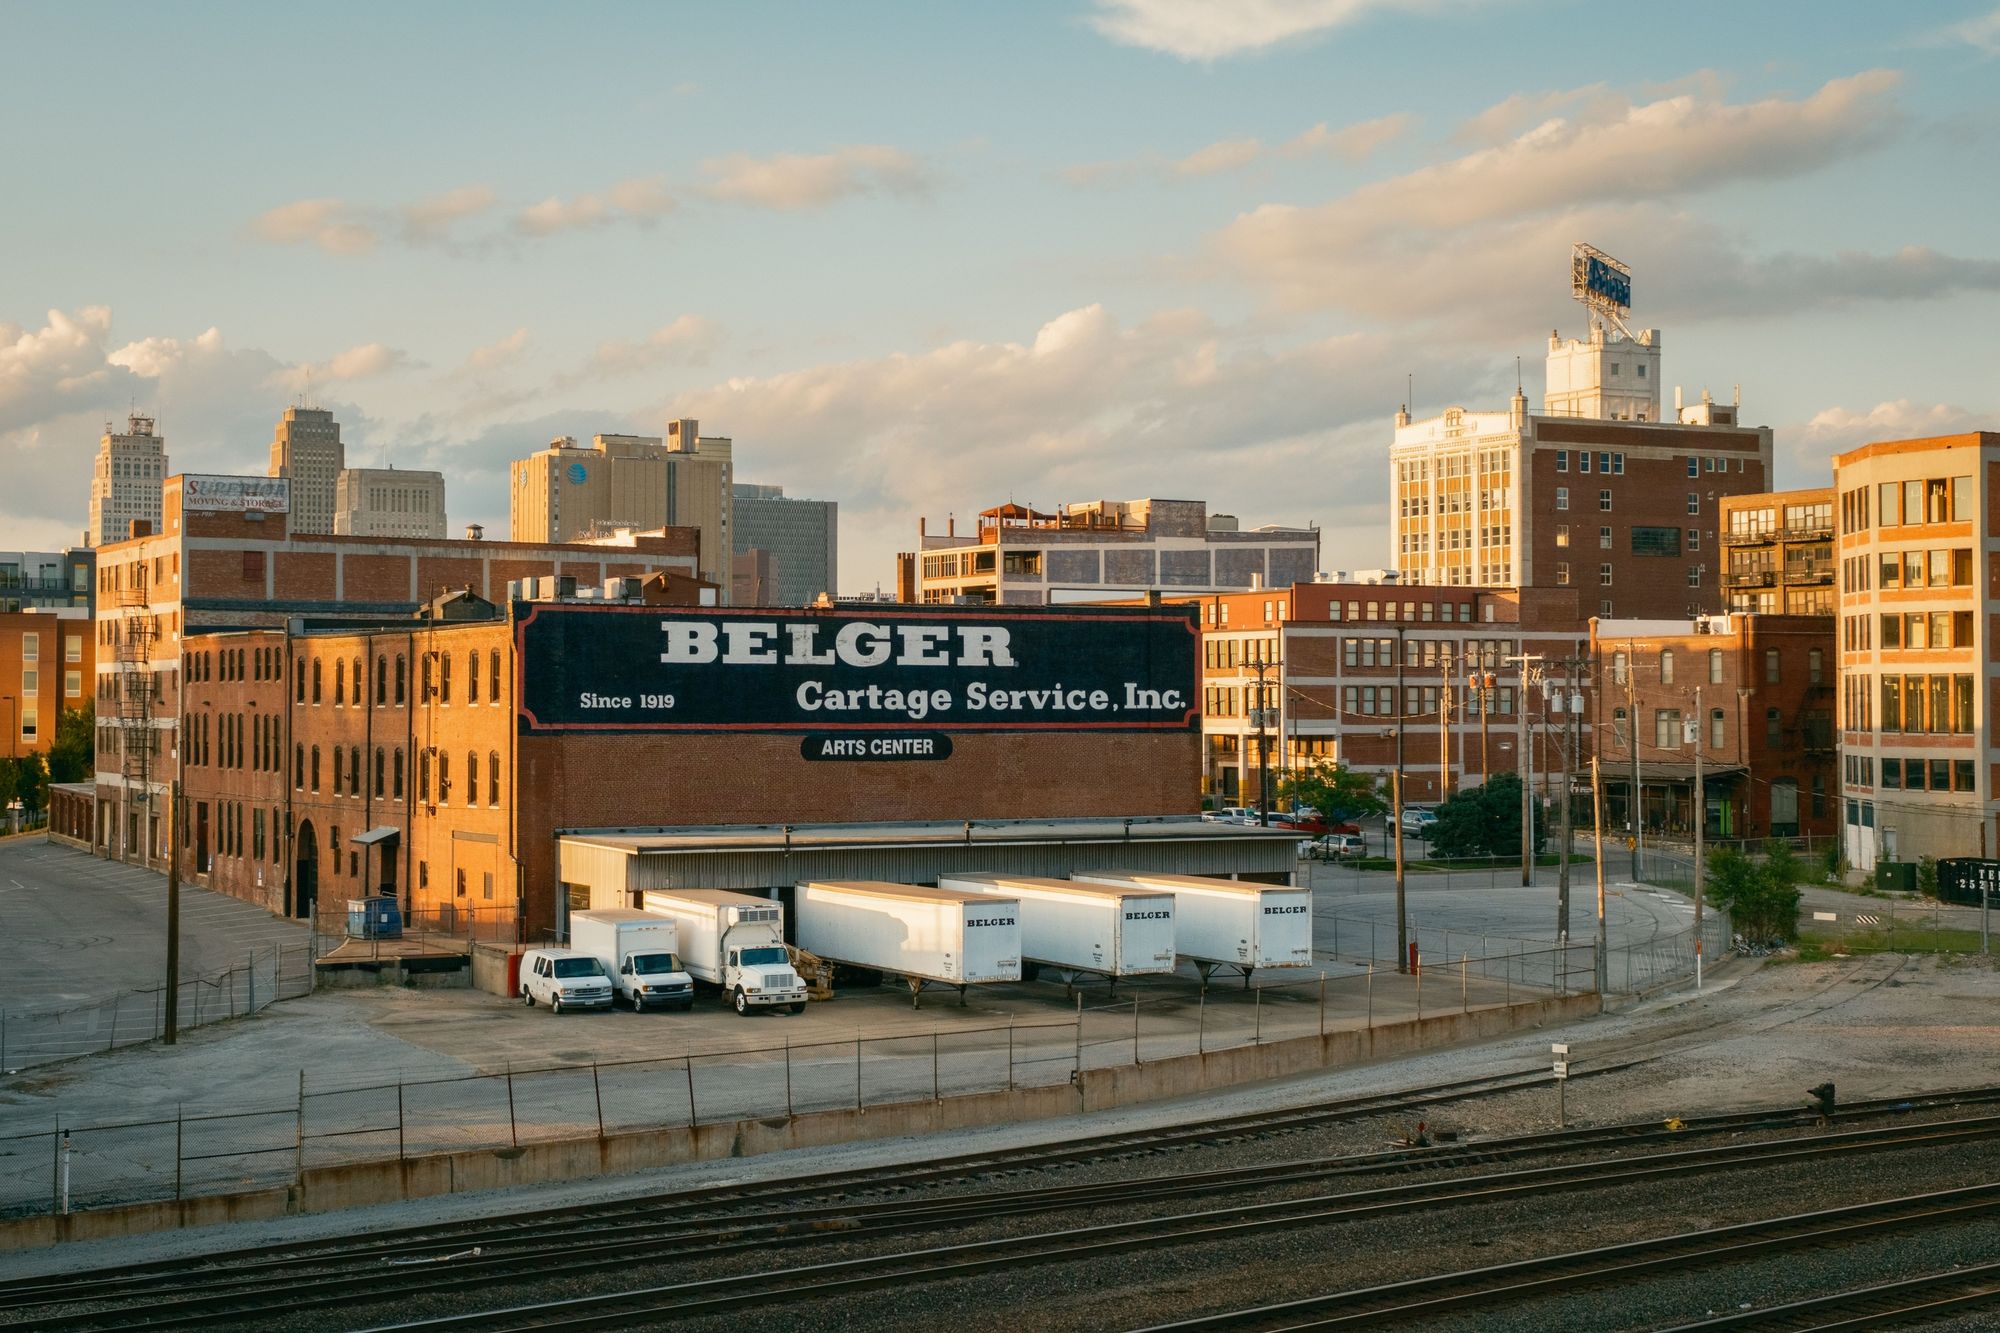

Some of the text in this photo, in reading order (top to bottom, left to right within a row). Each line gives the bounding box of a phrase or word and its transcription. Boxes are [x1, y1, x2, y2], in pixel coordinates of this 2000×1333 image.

[188, 497, 228, 506] MOVING
[660, 621, 1015, 667] BELGER
[580, 692, 675, 709] Since 1919
[796, 681, 952, 719] Cartage
[1124, 682, 1186, 709] Inc.
[821, 738, 934, 755] ARTS CENTER
[1959, 879, 2000, 892] 2521
[1126, 911, 1170, 920] BELGER
[1264, 905, 1307, 915] BELGER
[967, 918, 1015, 928] BELGER
